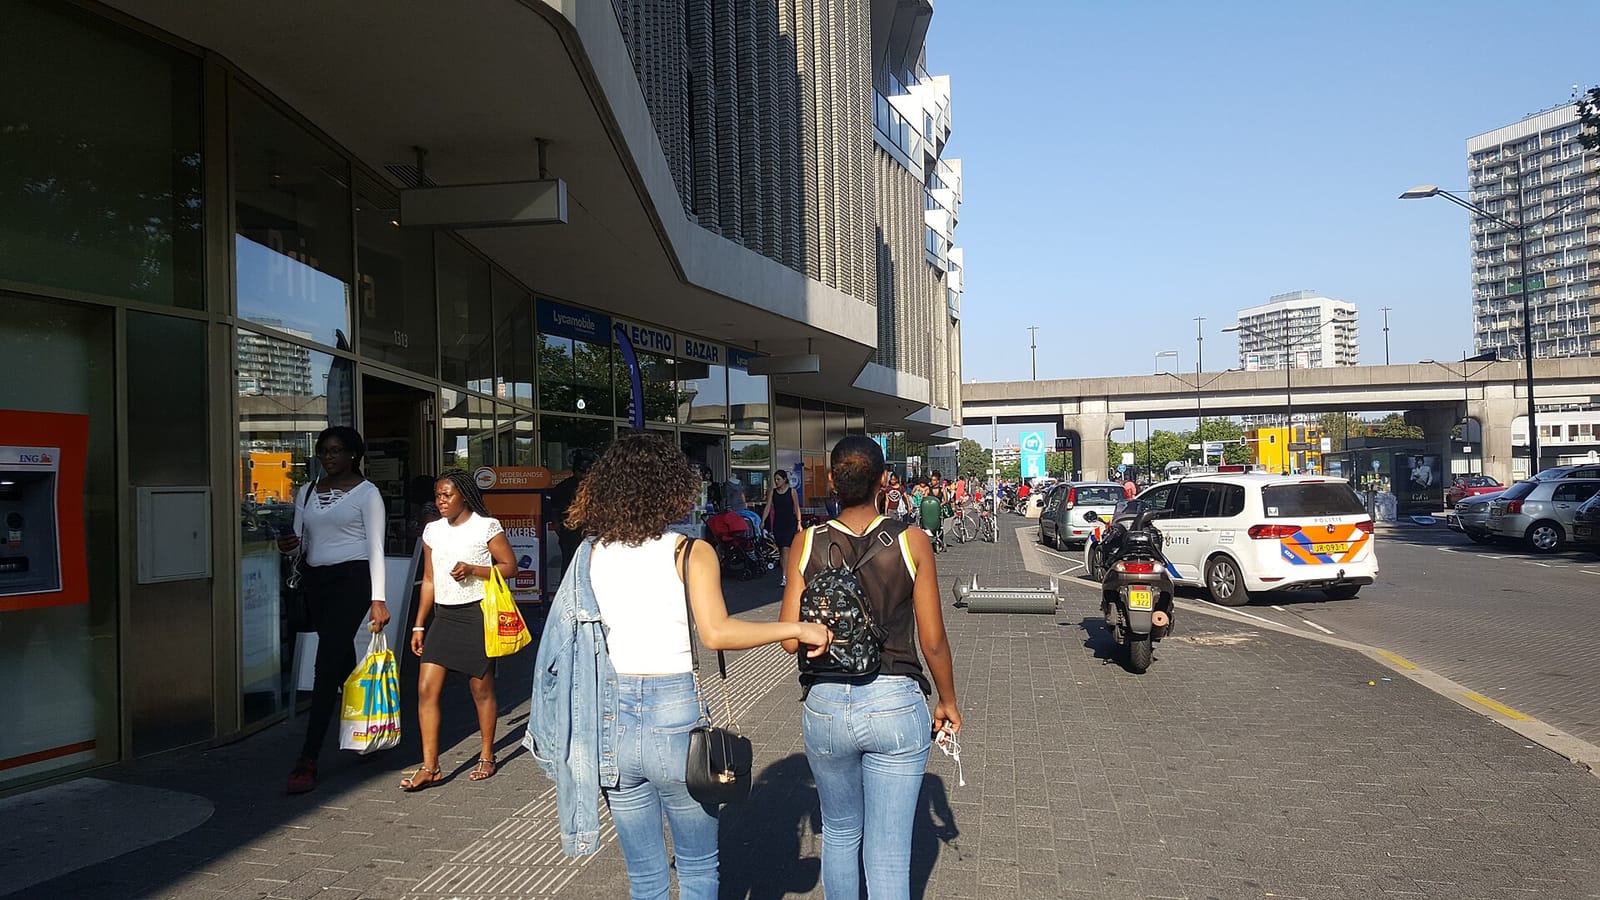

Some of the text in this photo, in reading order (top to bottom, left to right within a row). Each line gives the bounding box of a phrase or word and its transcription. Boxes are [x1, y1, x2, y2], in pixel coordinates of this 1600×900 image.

[553, 309, 595, 331] Lycamobile
[685, 340, 719, 362] BAZAR
[19, 454, 39, 463] ING
[499, 519, 536, 528] OORDEEL
[505, 527, 536, 537] KKERS
[360, 677, 400, 716] TAS
